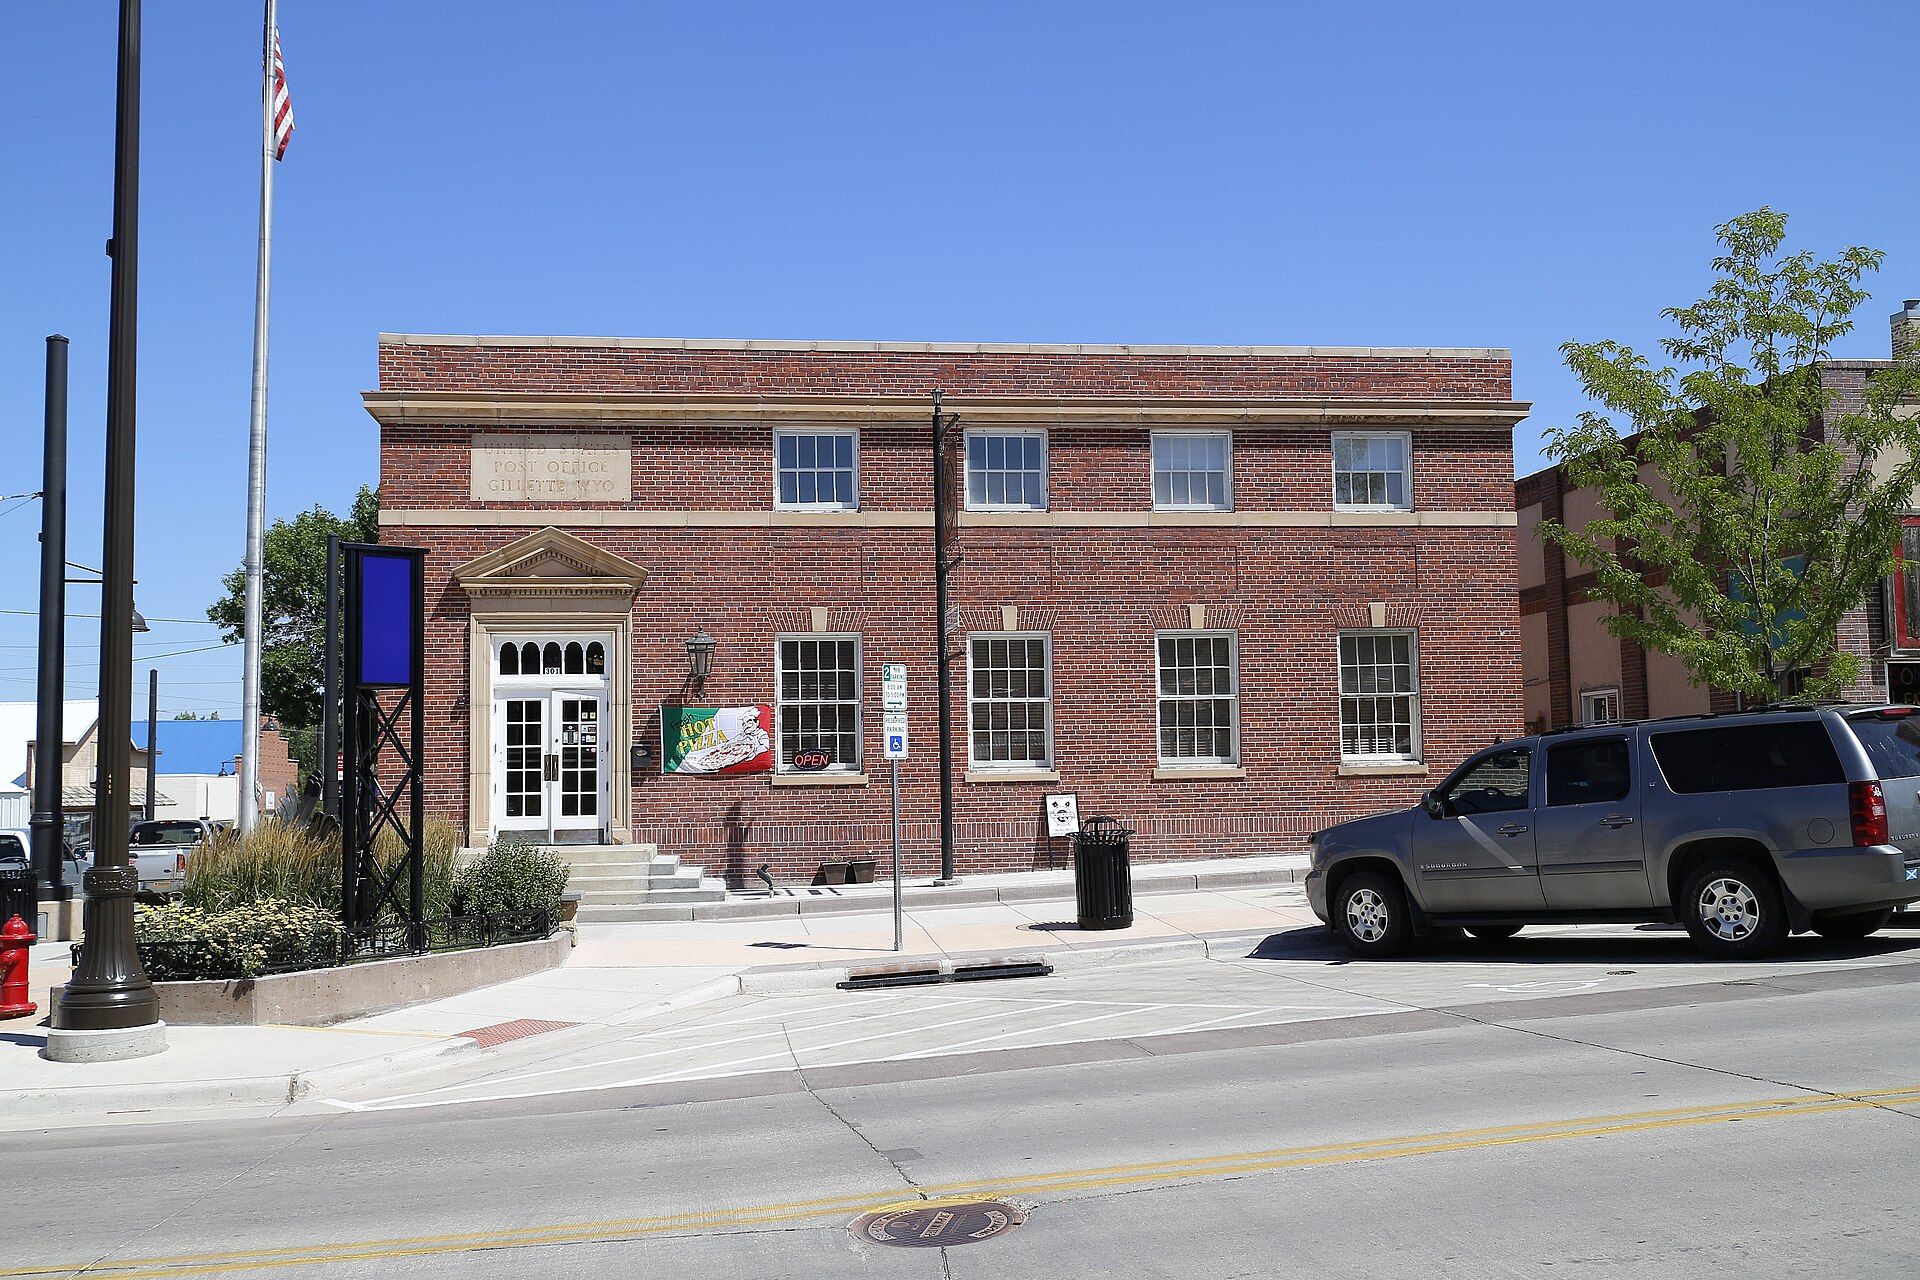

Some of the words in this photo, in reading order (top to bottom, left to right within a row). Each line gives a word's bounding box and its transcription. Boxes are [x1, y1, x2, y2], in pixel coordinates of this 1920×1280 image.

[494, 460, 537, 474] POST
[547, 460, 609, 474] OFFICE
[488, 479, 565, 493] GILLETTE
[577, 479, 615, 493] WYO
[545, 667, 560, 675] 301
[884, 667, 889, 679] 2
[670, 713, 695, 732] Fresh
[680, 718, 716, 738] HOT
[677, 730, 729, 755] PIZZA
[794, 754, 829, 766] OPEN
